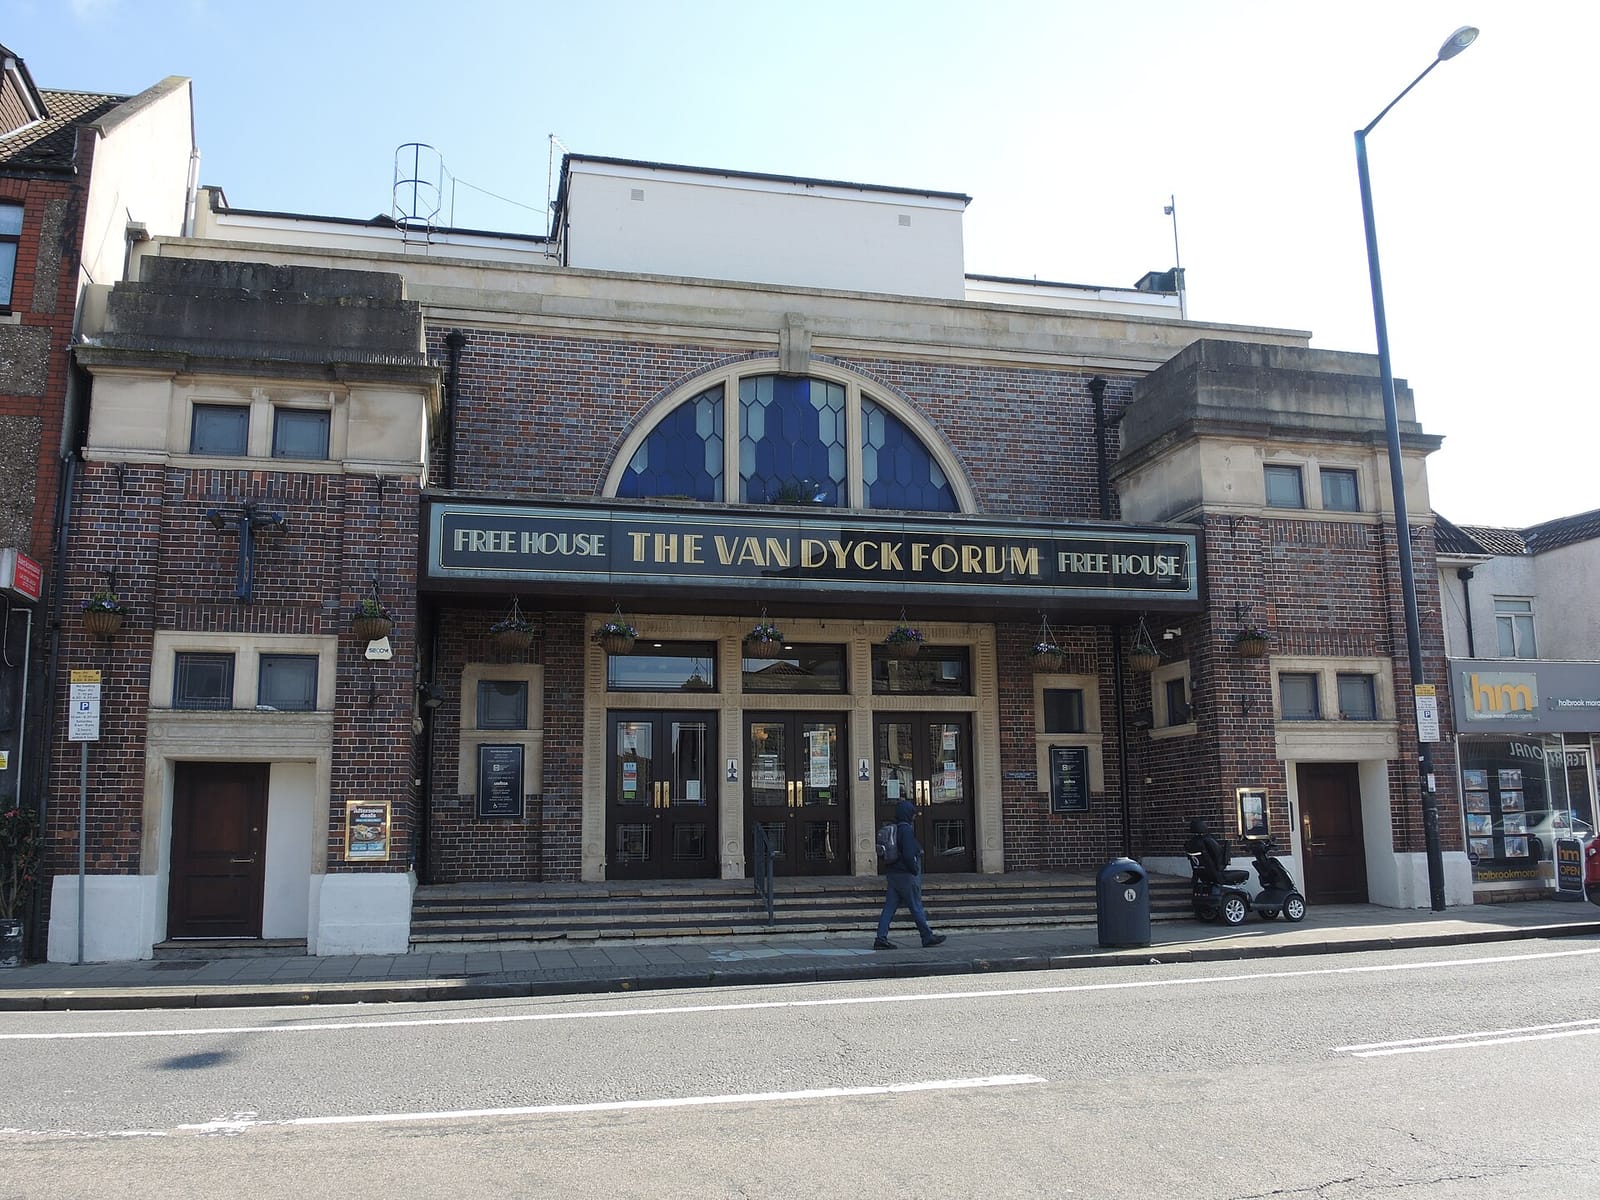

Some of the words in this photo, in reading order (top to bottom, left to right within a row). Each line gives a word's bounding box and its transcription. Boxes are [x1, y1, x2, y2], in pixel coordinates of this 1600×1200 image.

[453, 529, 517, 554] FREE
[521, 531, 606, 558] HOUSE
[627, 531, 705, 564] THE
[713, 535, 791, 568] VAN
[801, 539, 904, 572] DYCK
[912, 543, 1039, 576] FORUM
[1058, 551, 1109, 575] FREE
[1112, 553, 1181, 577] HOUSE
[1471, 673, 1533, 711] hm
[1560, 865, 1581, 876] OPEN
